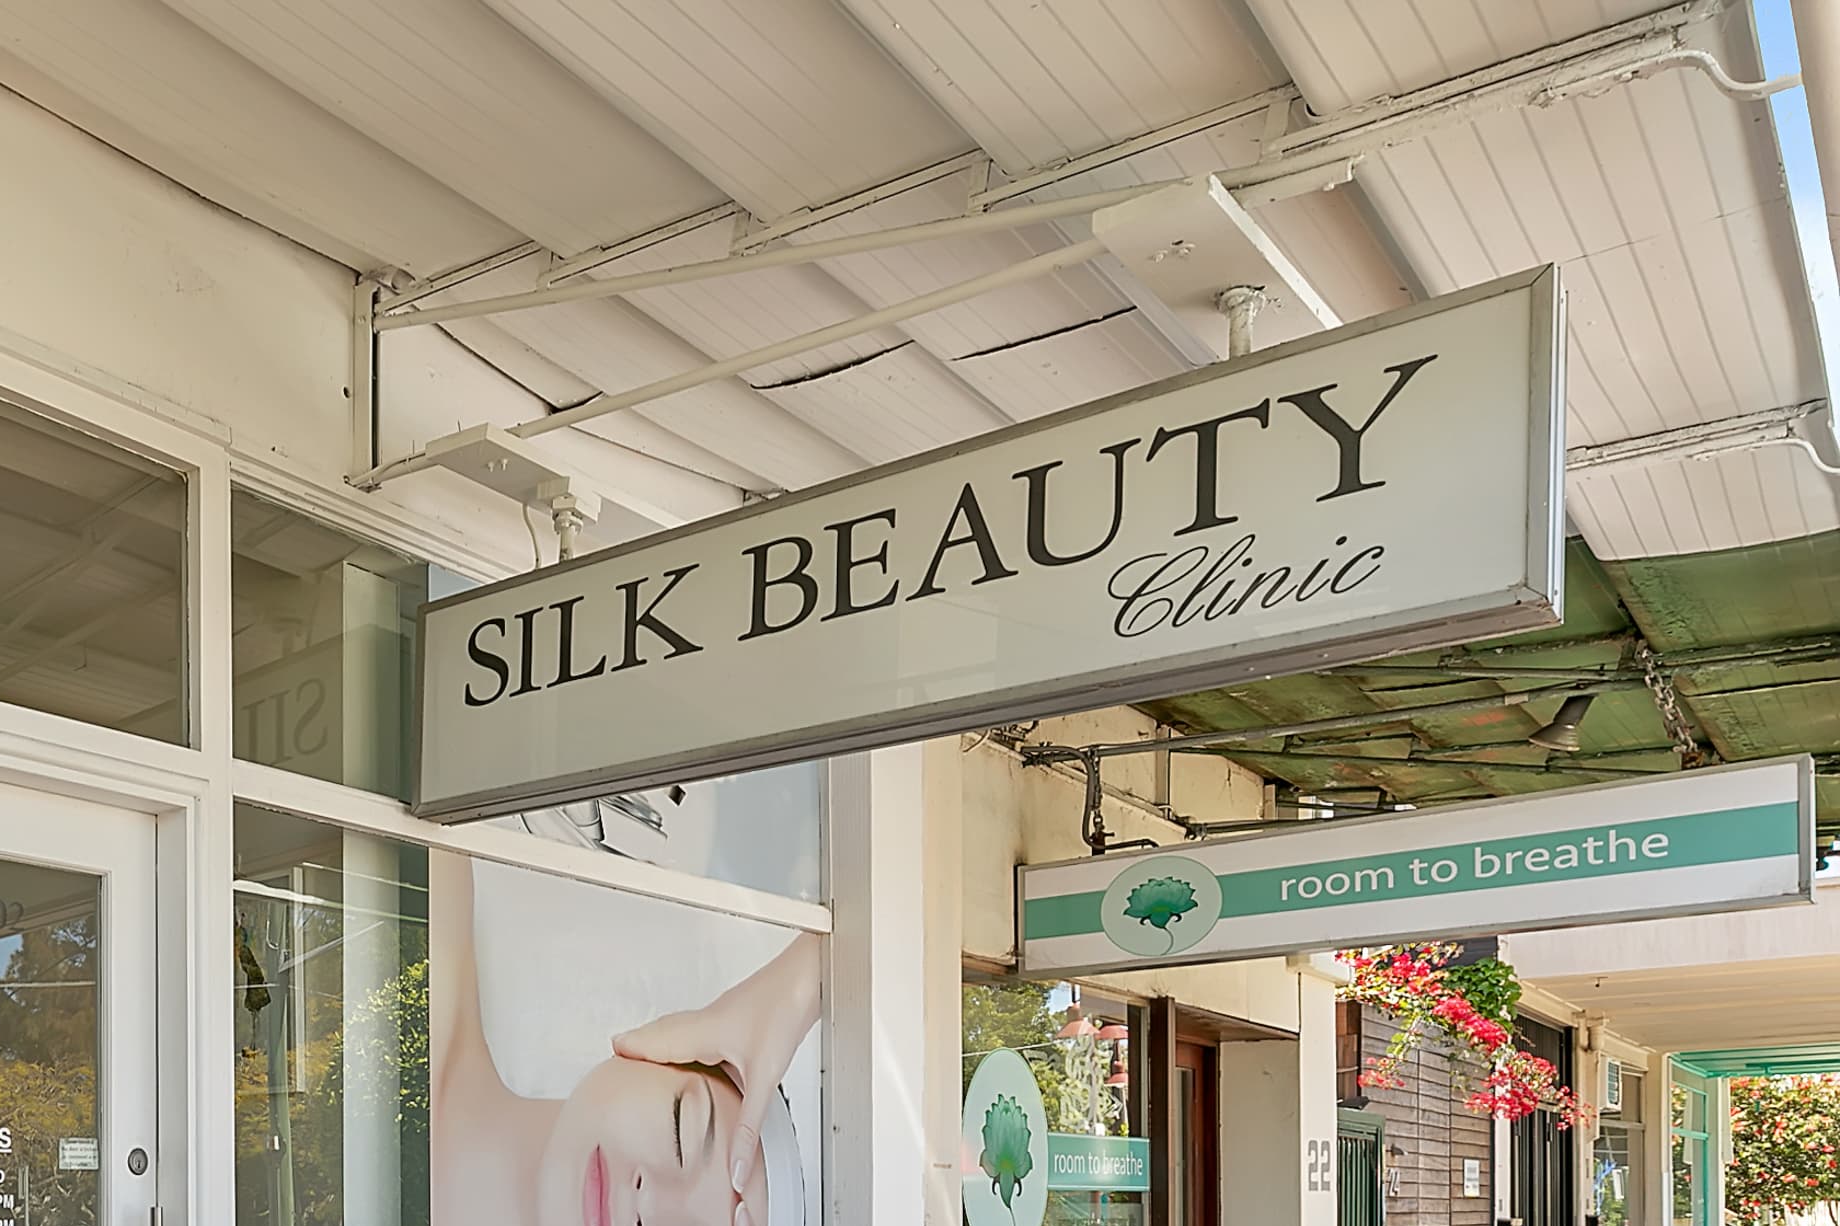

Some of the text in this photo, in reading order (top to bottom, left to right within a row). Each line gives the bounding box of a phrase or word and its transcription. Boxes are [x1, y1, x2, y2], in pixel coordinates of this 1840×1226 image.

[464, 352, 1438, 706] SILK BEAUTY
[1107, 531, 1385, 639] Clinic
[1280, 829, 1670, 902] room to breathe
[1054, 1150, 1143, 1176] room to breathe
[1307, 1140, 1331, 1191] 22
